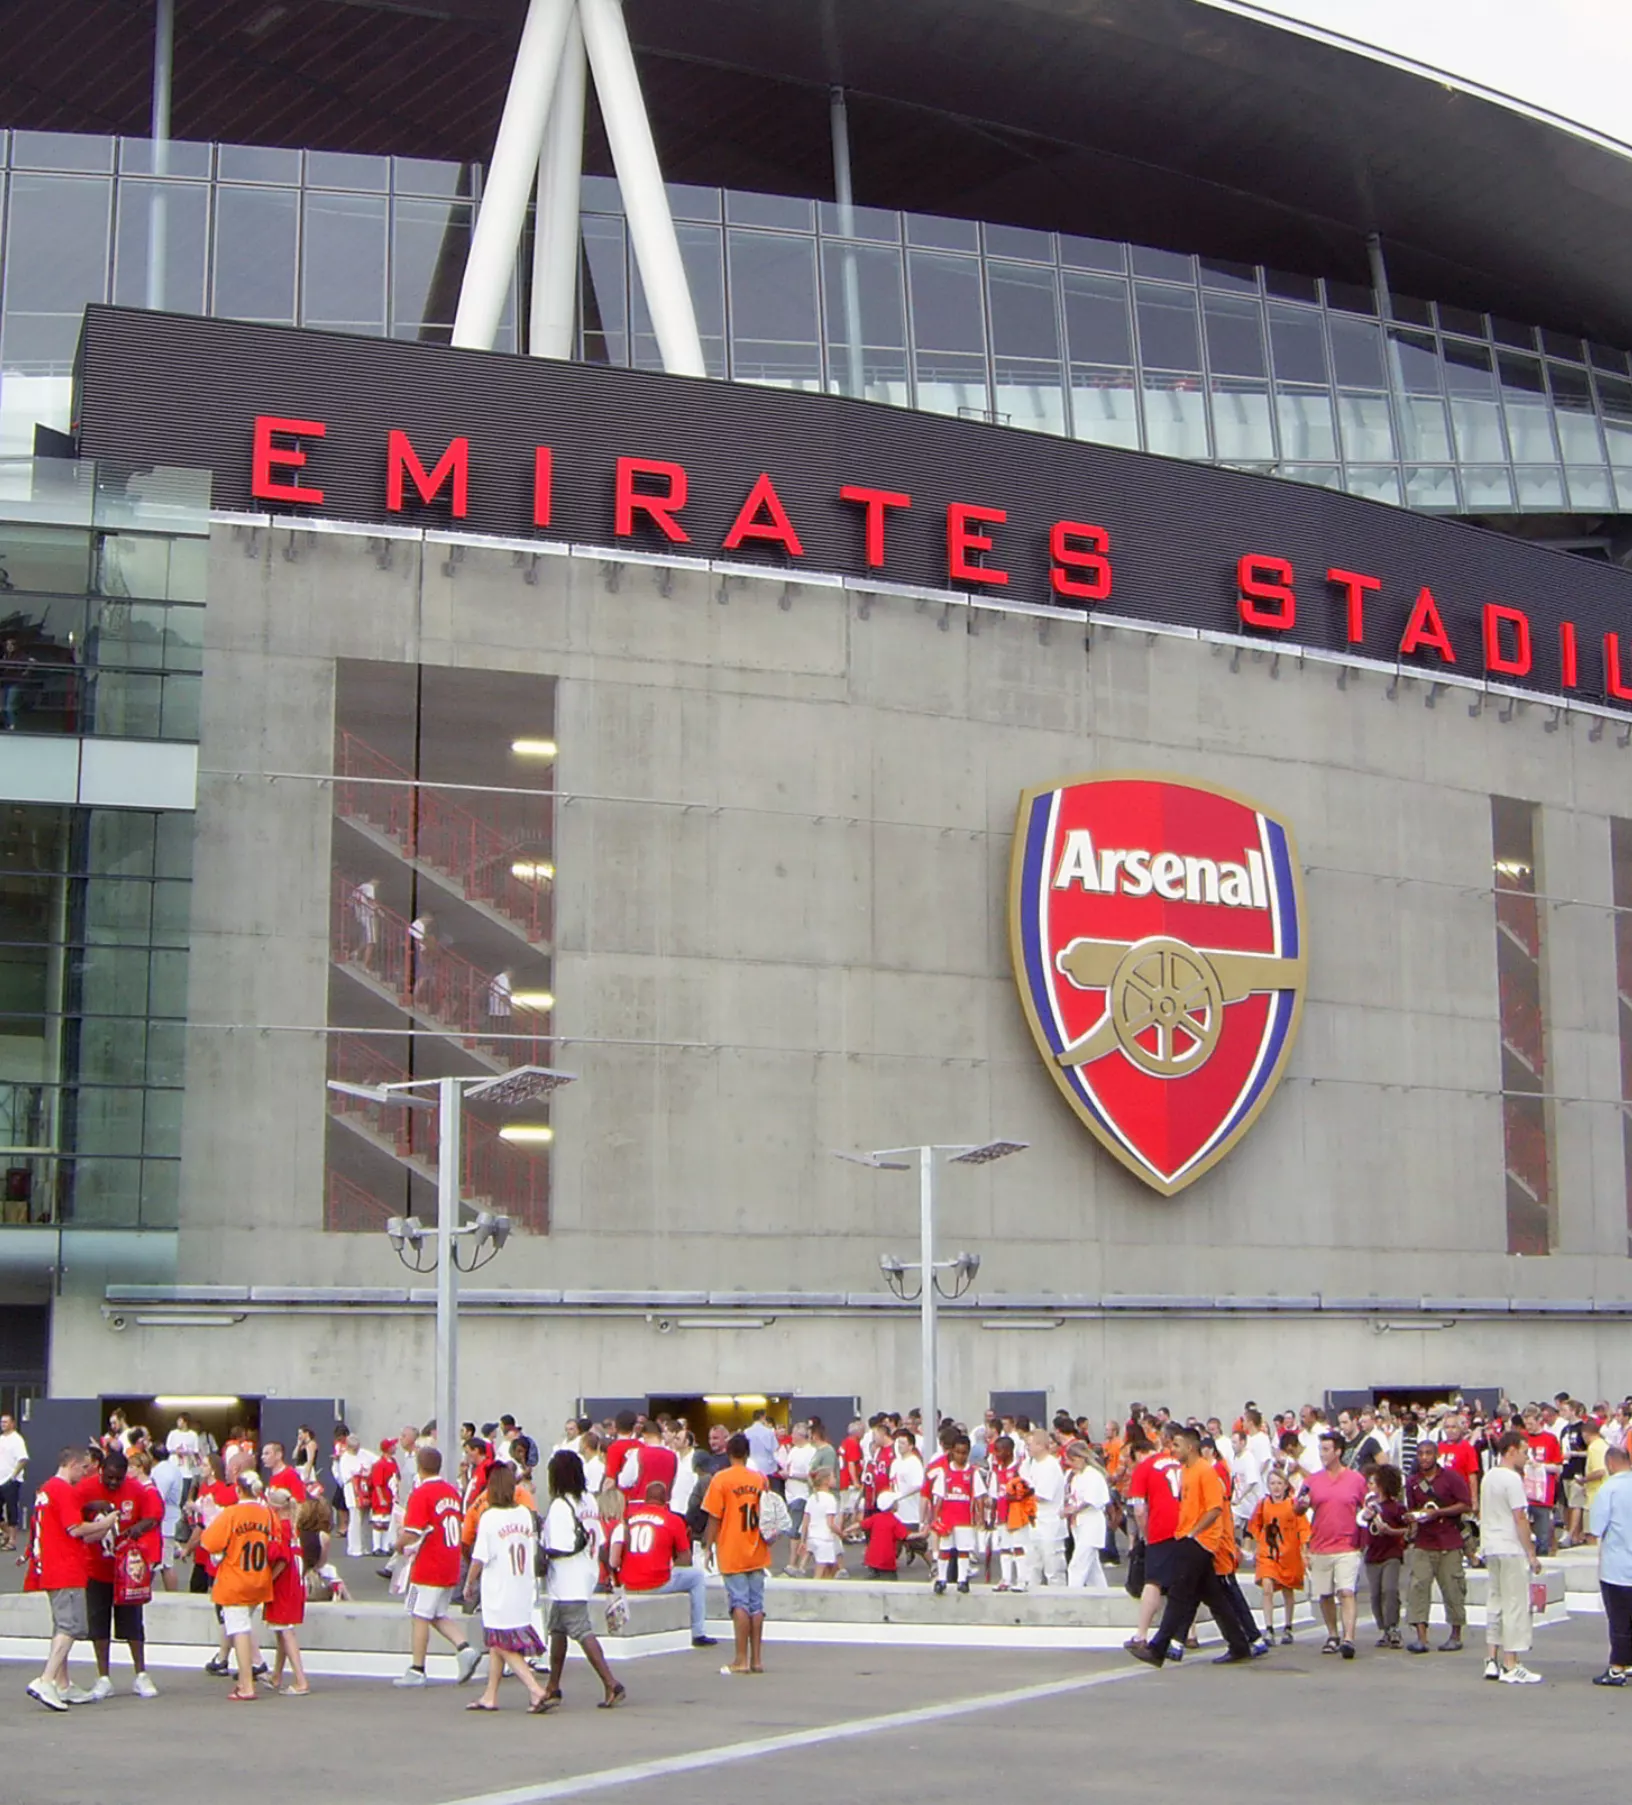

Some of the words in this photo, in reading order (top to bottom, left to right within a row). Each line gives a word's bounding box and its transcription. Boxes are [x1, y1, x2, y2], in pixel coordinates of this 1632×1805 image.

[251, 414, 1113, 600] EMIRATES
[1053, 829, 1268, 908] Arsenal
[442, 1515, 460, 1548] 10
[630, 1525, 653, 1554] 10
[242, 1541, 266, 1572] 10
[509, 1543, 526, 1576] 10
